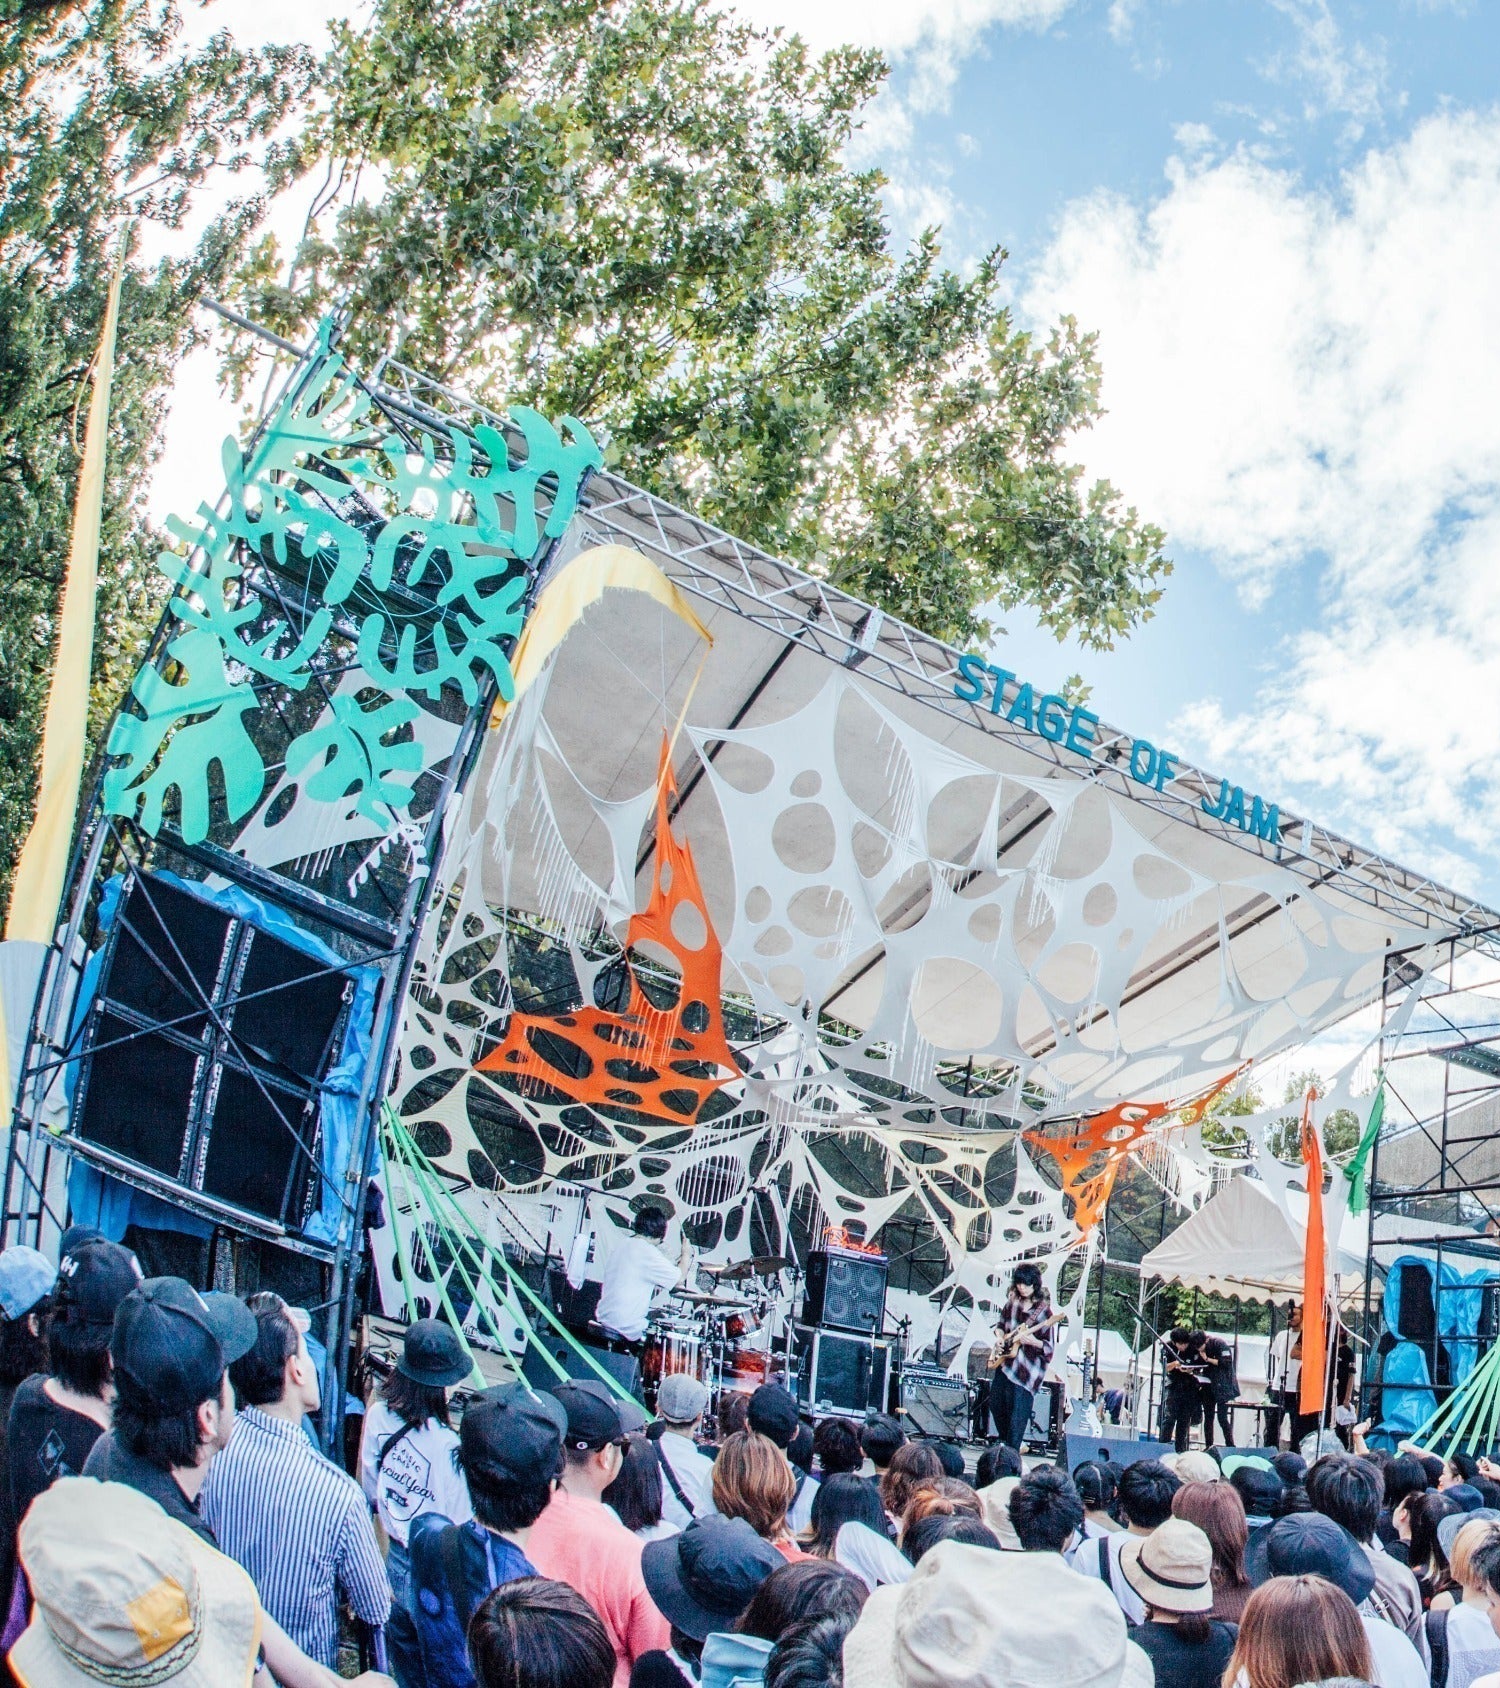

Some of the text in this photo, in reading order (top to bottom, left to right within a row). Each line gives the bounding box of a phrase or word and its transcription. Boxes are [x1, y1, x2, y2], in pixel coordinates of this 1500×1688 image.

[954, 654, 1279, 843] STAGE OF JAM
